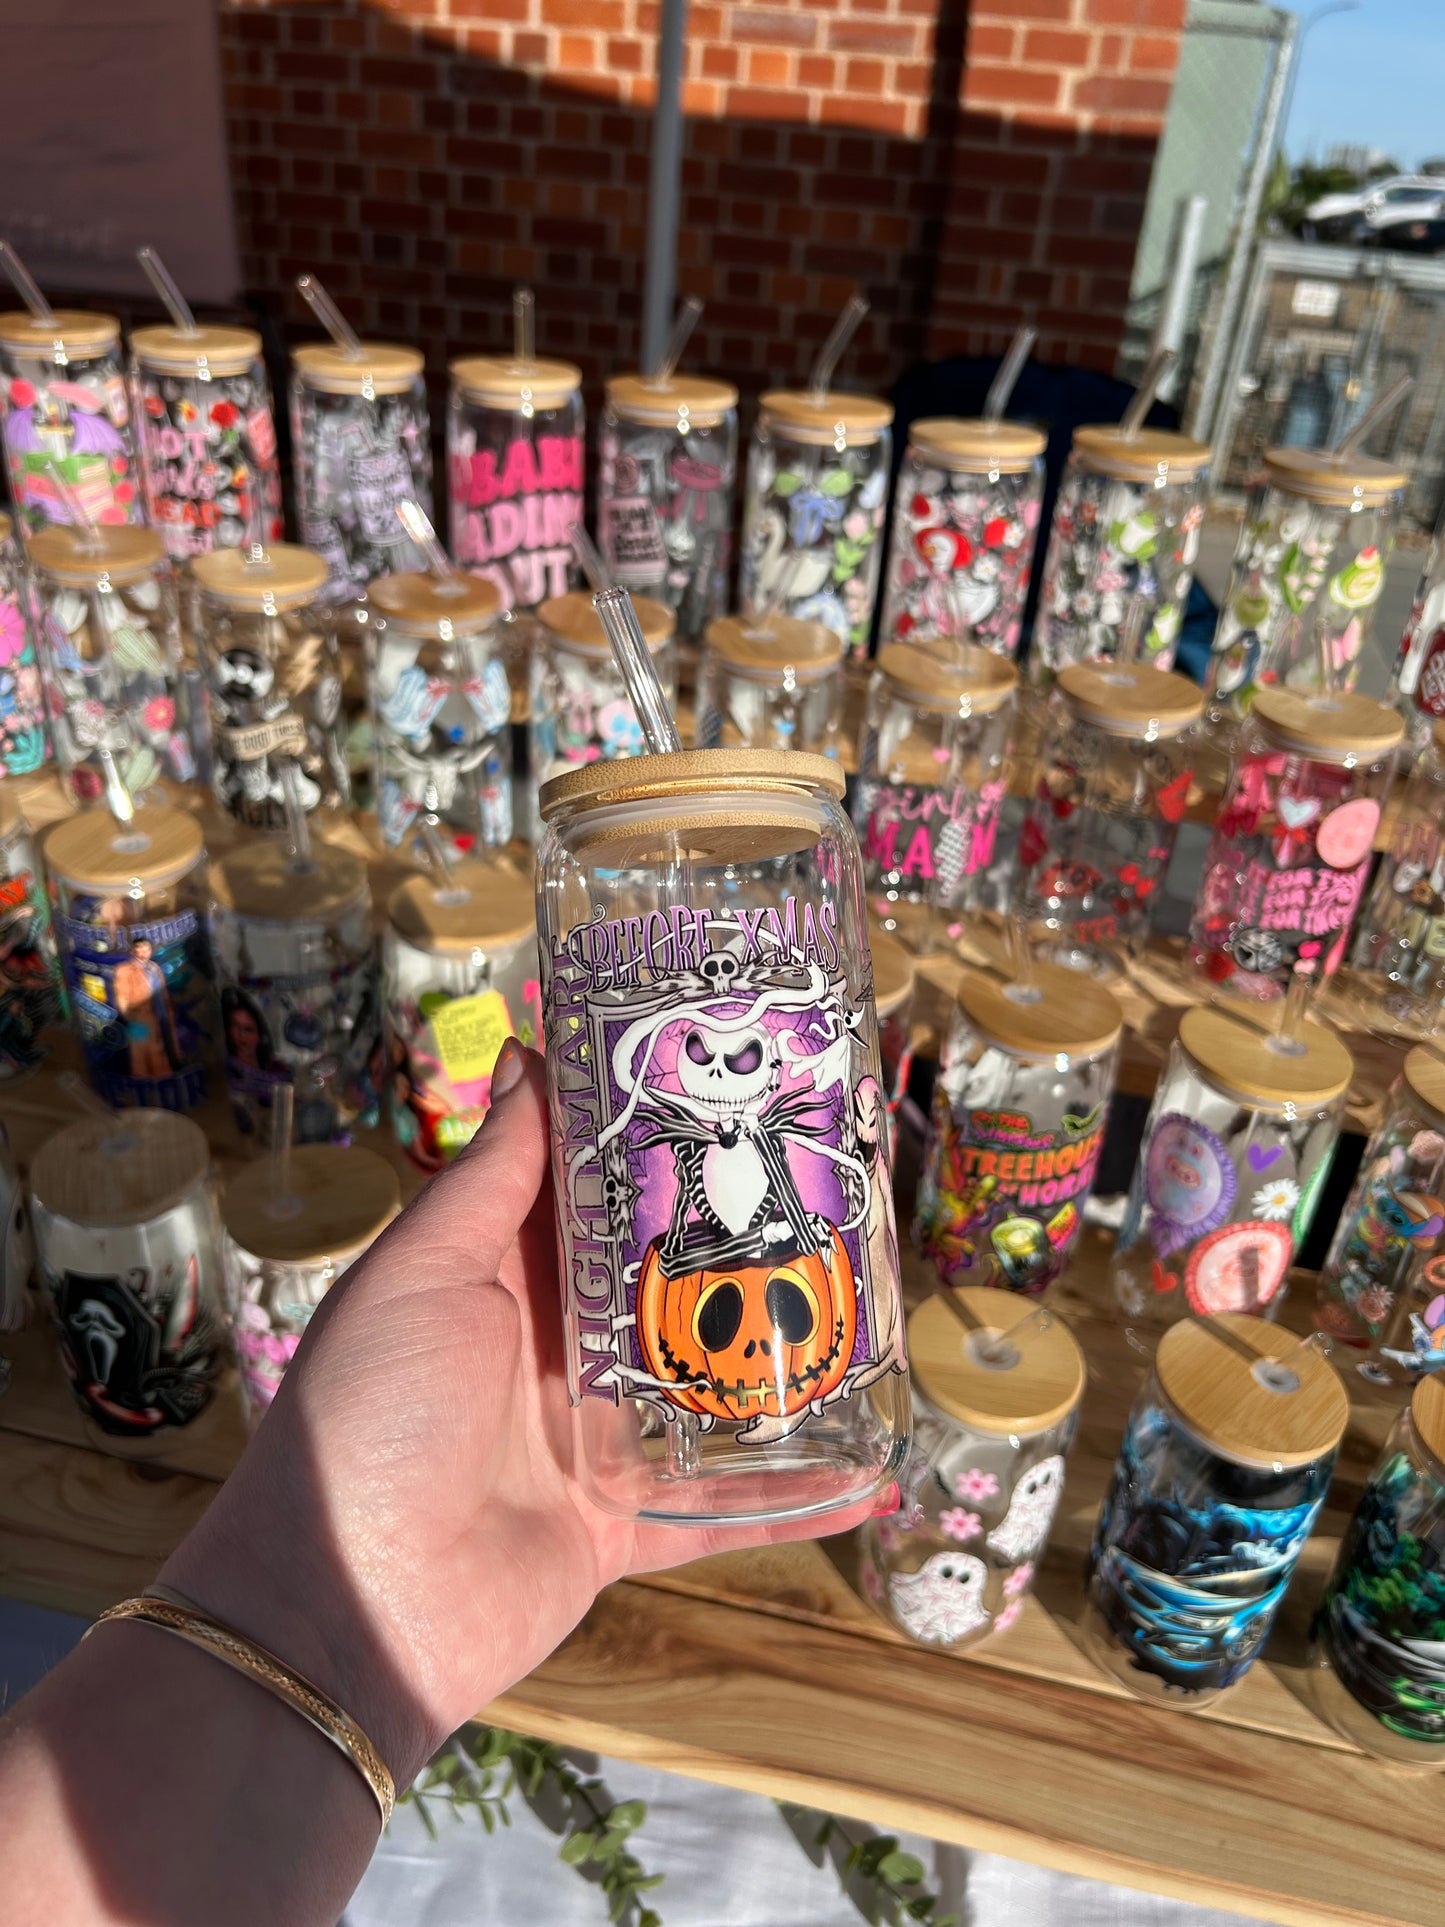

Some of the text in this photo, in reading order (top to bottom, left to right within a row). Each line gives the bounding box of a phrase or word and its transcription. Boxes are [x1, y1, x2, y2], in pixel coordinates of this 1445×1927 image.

[587, 895, 842, 995] BEFORE XMAS
[551, 935, 619, 1407] NIGHTMARE
